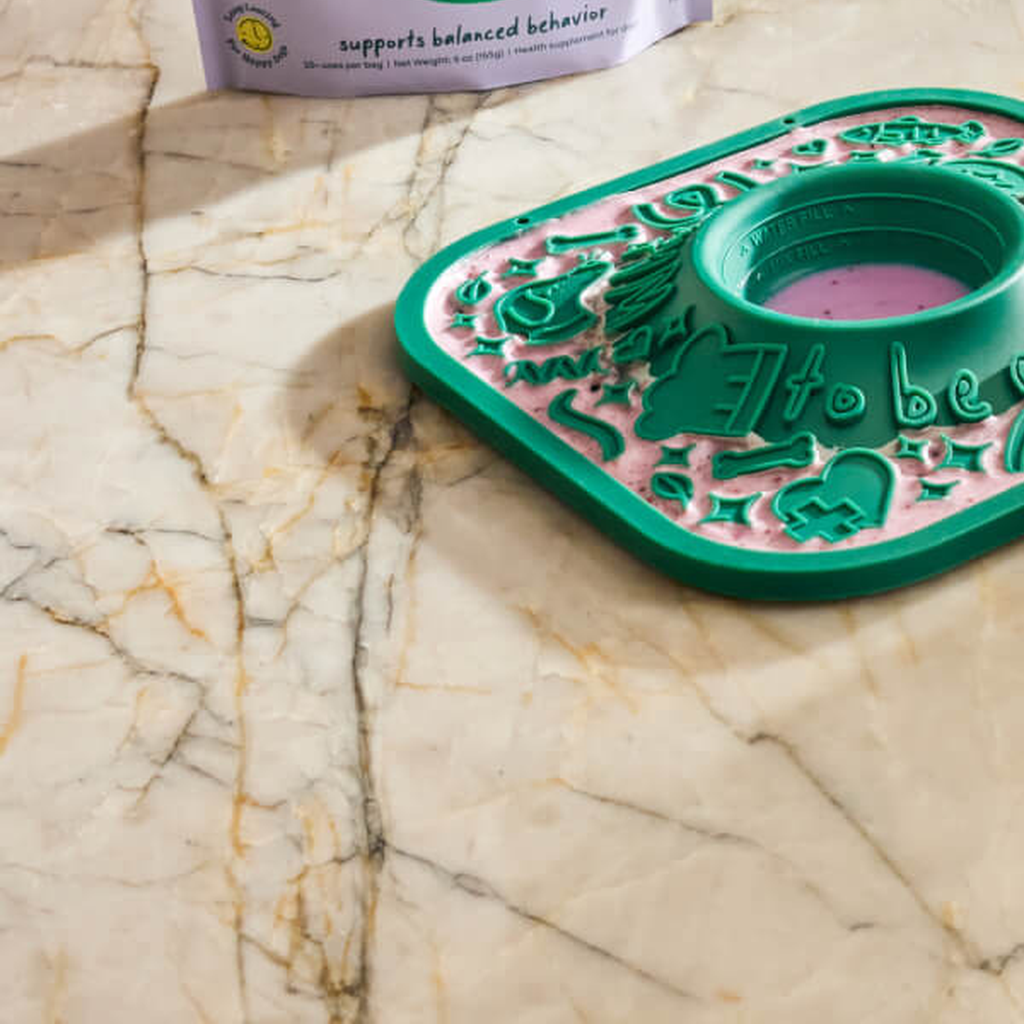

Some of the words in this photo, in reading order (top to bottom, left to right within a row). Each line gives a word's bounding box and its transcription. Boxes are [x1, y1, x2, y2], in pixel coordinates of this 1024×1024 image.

[339, 29, 425, 57] supports
[432, 16, 519, 47] balanced
[527, 4, 607, 36] behavior
[784, 342, 867, 425] to
[890, 340, 993, 429] be
